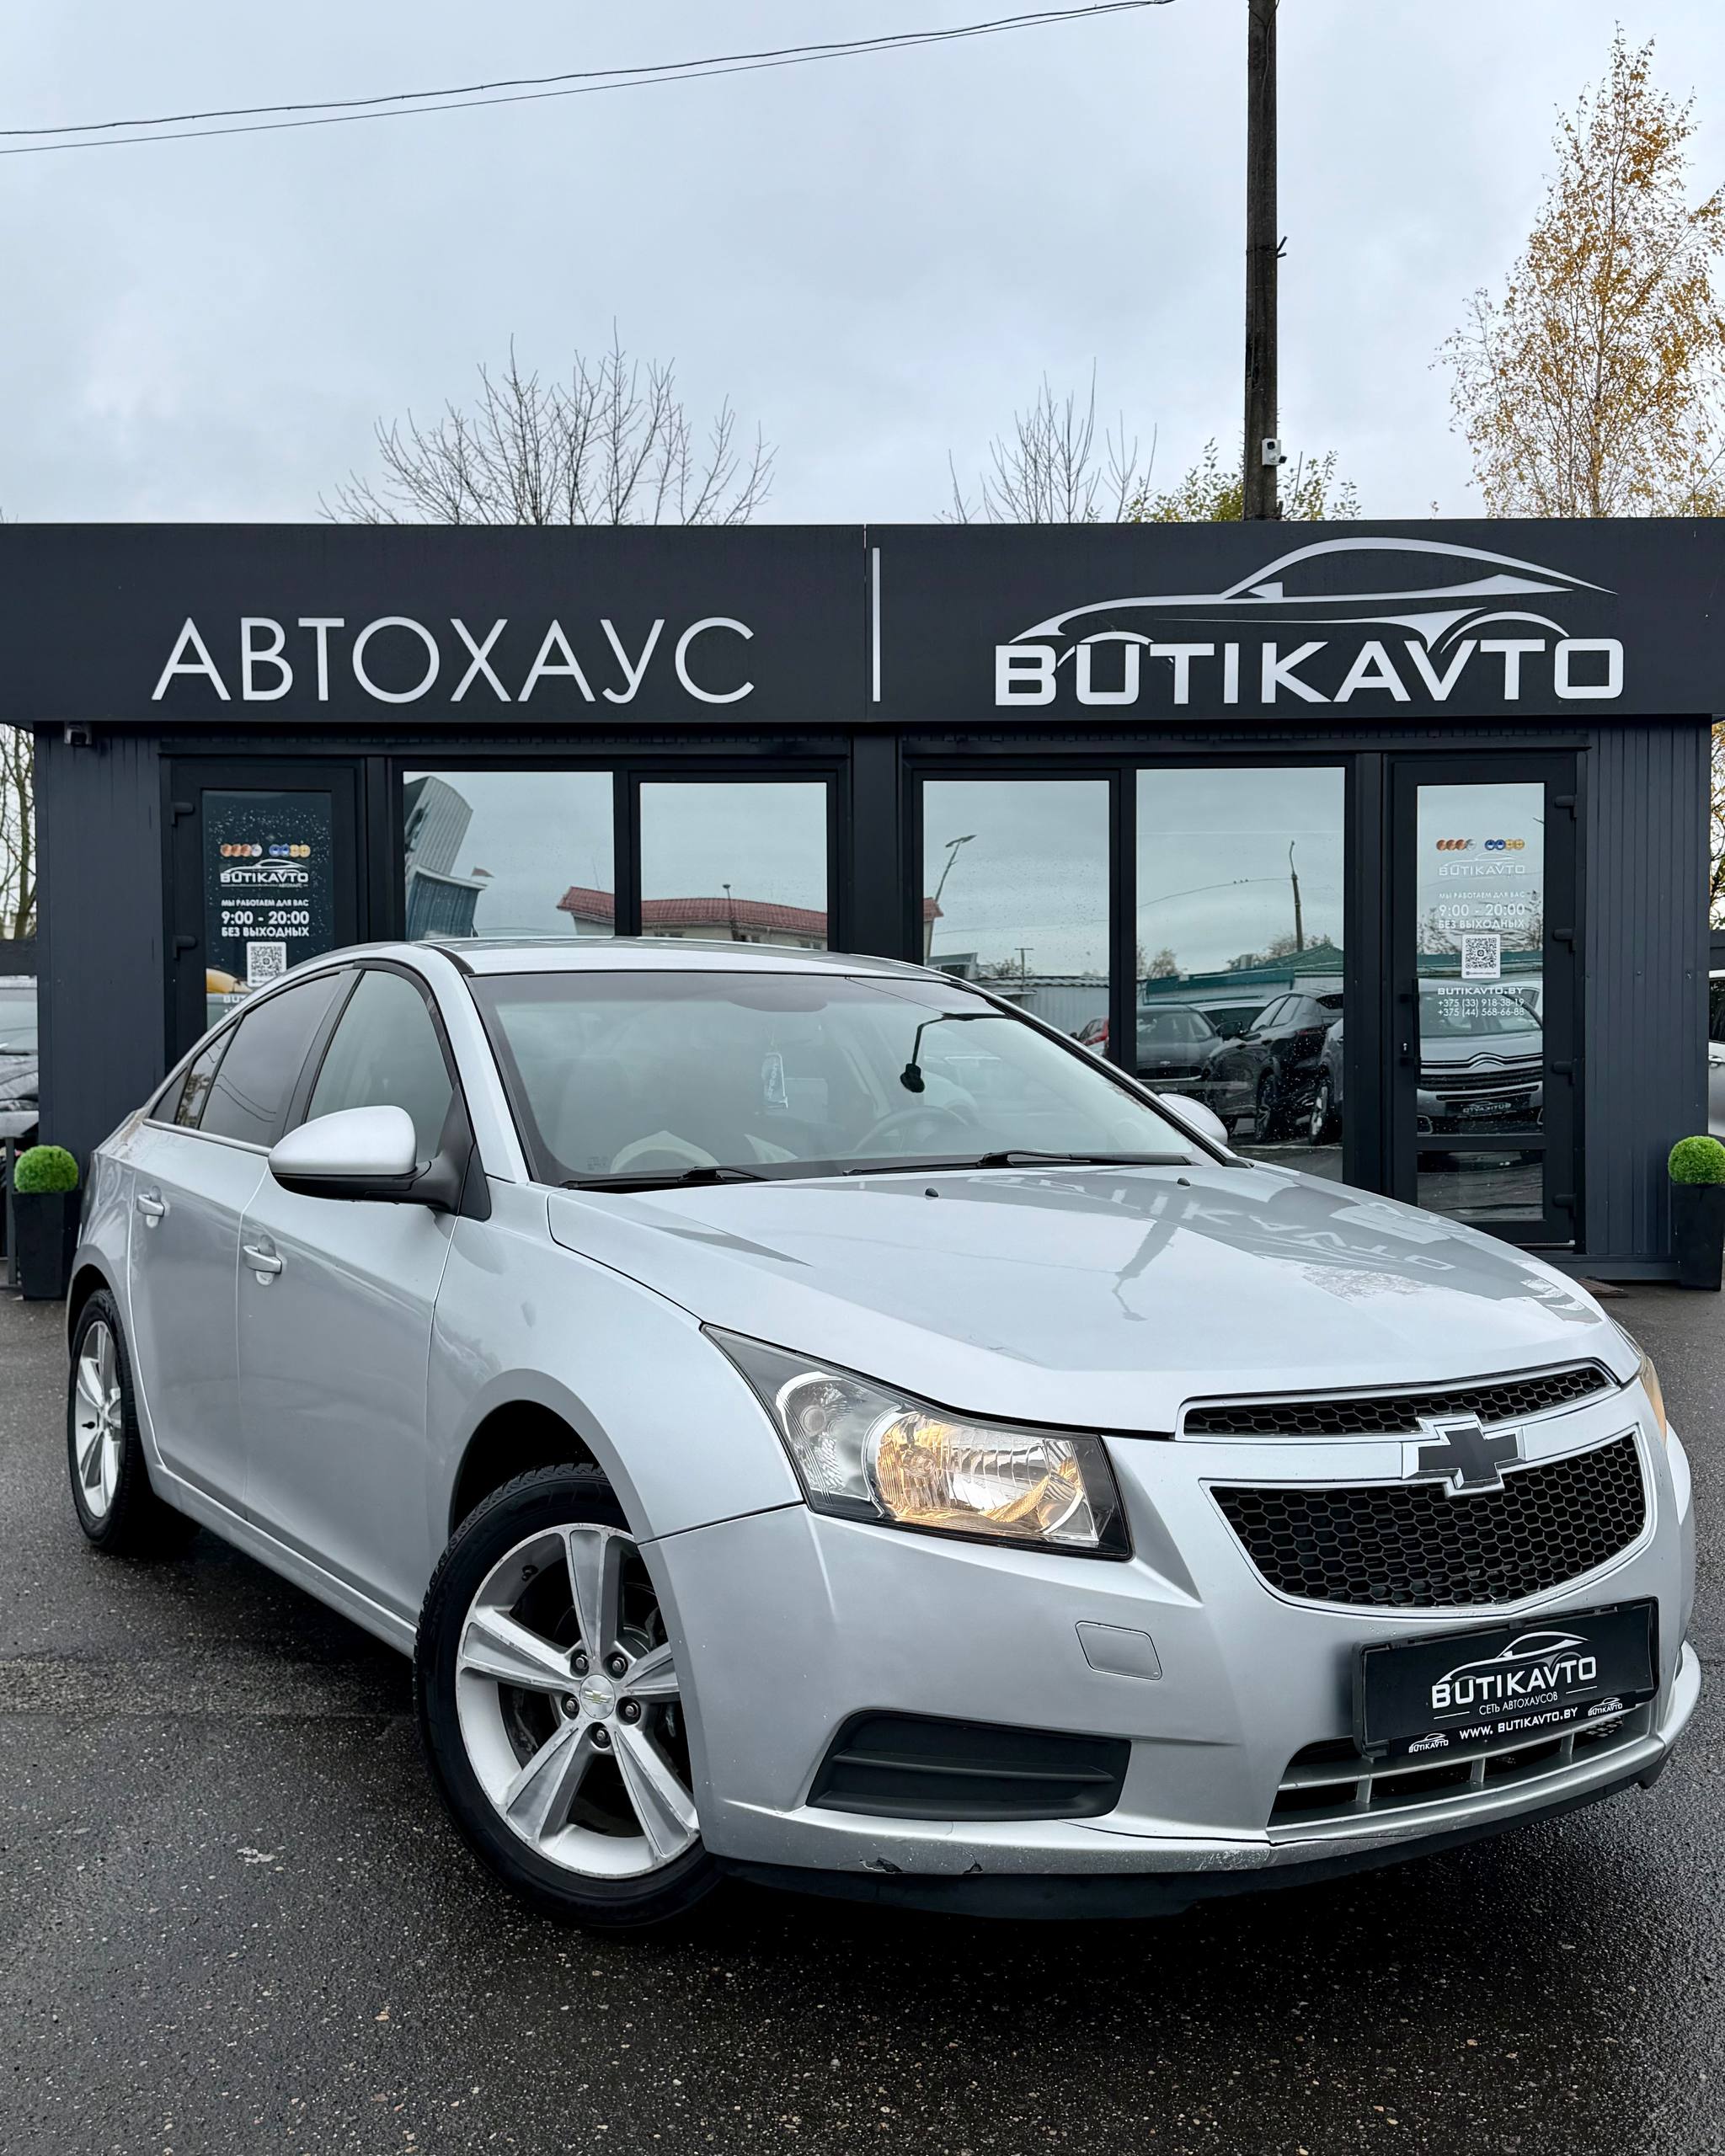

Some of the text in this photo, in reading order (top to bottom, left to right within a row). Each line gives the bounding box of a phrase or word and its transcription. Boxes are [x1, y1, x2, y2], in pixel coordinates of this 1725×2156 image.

[152, 616, 755, 704] АВТОХАУС
[995, 638, 1625, 706] BUTIKAVTO
[1439, 864, 1525, 876] BUTIKAVTO
[220, 872, 309, 883] BUTIKAVTO
[221, 899, 309, 907] МЫ РАБОТАЕМ ДЛЯ ВАС
[1439, 904, 1469, 916] 9:00
[1485, 903, 1525, 916] 20:00
[221, 910, 254, 925] 9:00
[268, 910, 310, 925] 20:00
[1439, 919, 1525, 930] БЕЗ ВЫХОДНЫХ
[221, 926, 310, 937] БЕЗ ВЫХОДНЫХ
[1438, 987, 1524, 995] BUTIKAVTO.BY
[1438, 998, 1525, 1009] +375 (33) 918-38-19
[1438, 1007, 1525, 1018] +375 (44) 568-66-88
[1431, 1656, 1597, 1710] BUTIKAVTO
[1478, 1691, 1558, 1716] СЕТЬ АВТОХАУСОВ
[1588, 1703, 1623, 1716] BUTIKAVTO
[1459, 1707, 1578, 1740] WWW. BUTIKAVTO.BY
[1408, 1739, 1449, 1753] BUTIKAVTO
